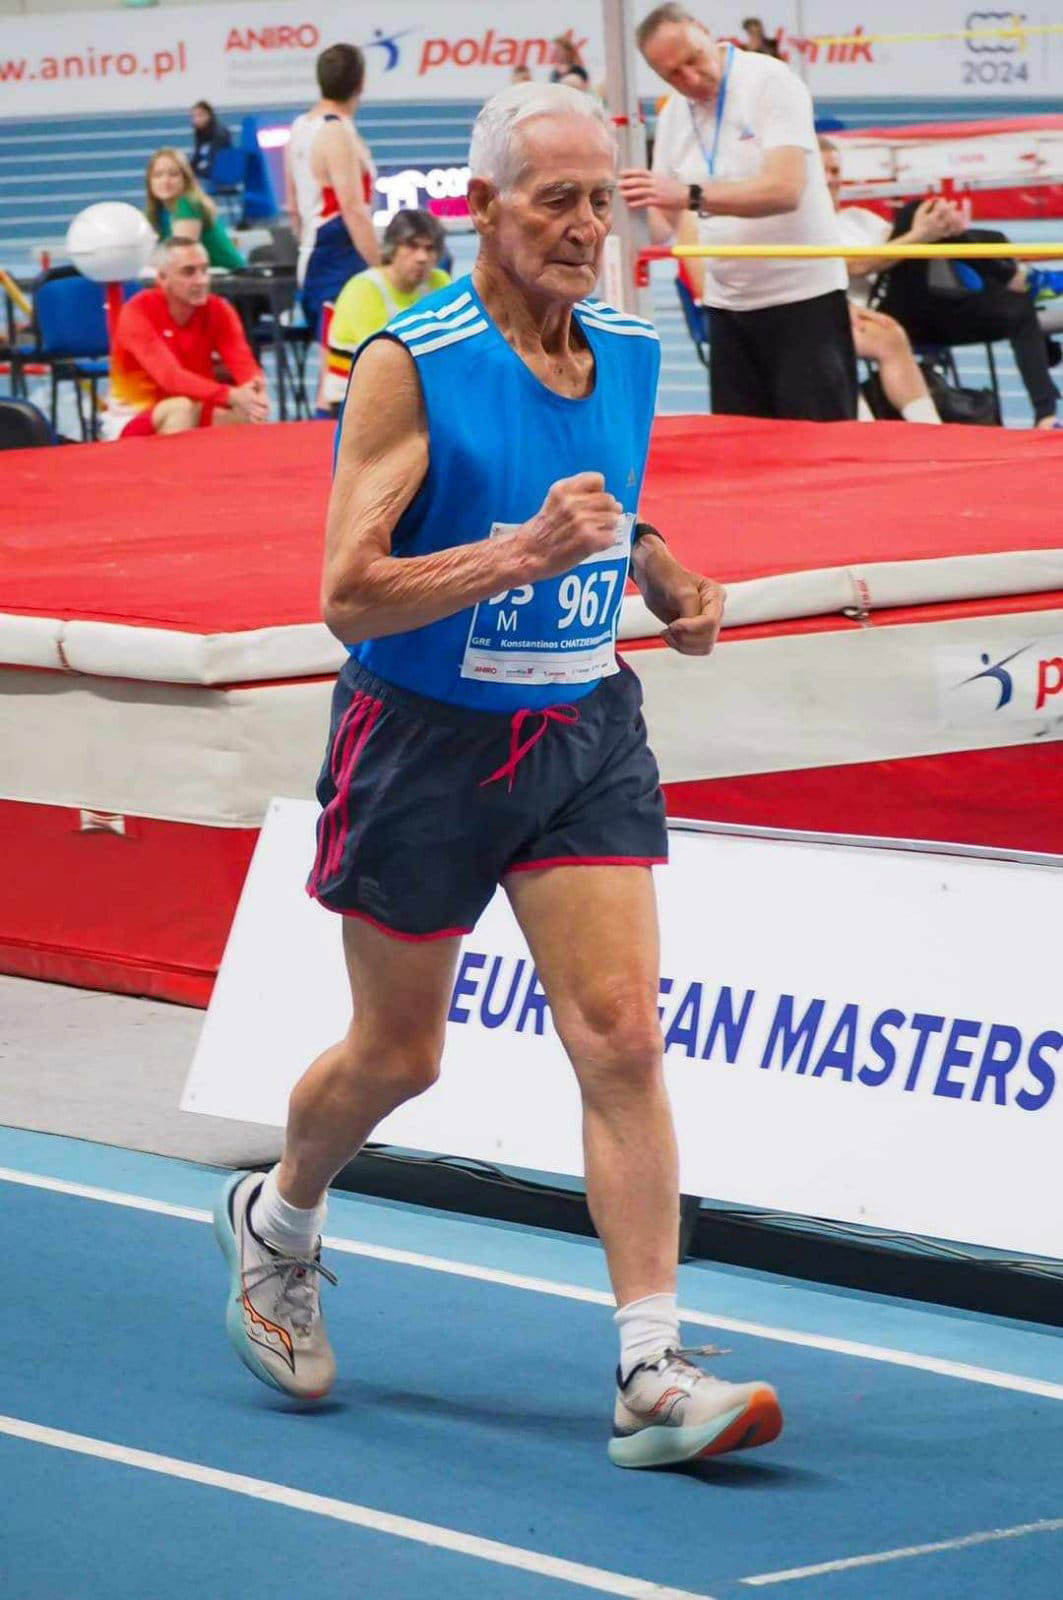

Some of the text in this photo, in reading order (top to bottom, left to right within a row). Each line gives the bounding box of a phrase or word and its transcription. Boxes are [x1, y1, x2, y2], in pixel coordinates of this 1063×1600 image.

[225, 24, 319, 52] ANIRO
[419, 28, 588, 76] polank
[962, 61, 1028, 84] 2024
[558, 570, 618, 629] 967
[497, 610, 517, 631] M
[471, 637, 491, 647] GRE
[501, 639, 558, 648] Konstantinos
[448, 951, 1063, 1111] EURAN MASTERS
